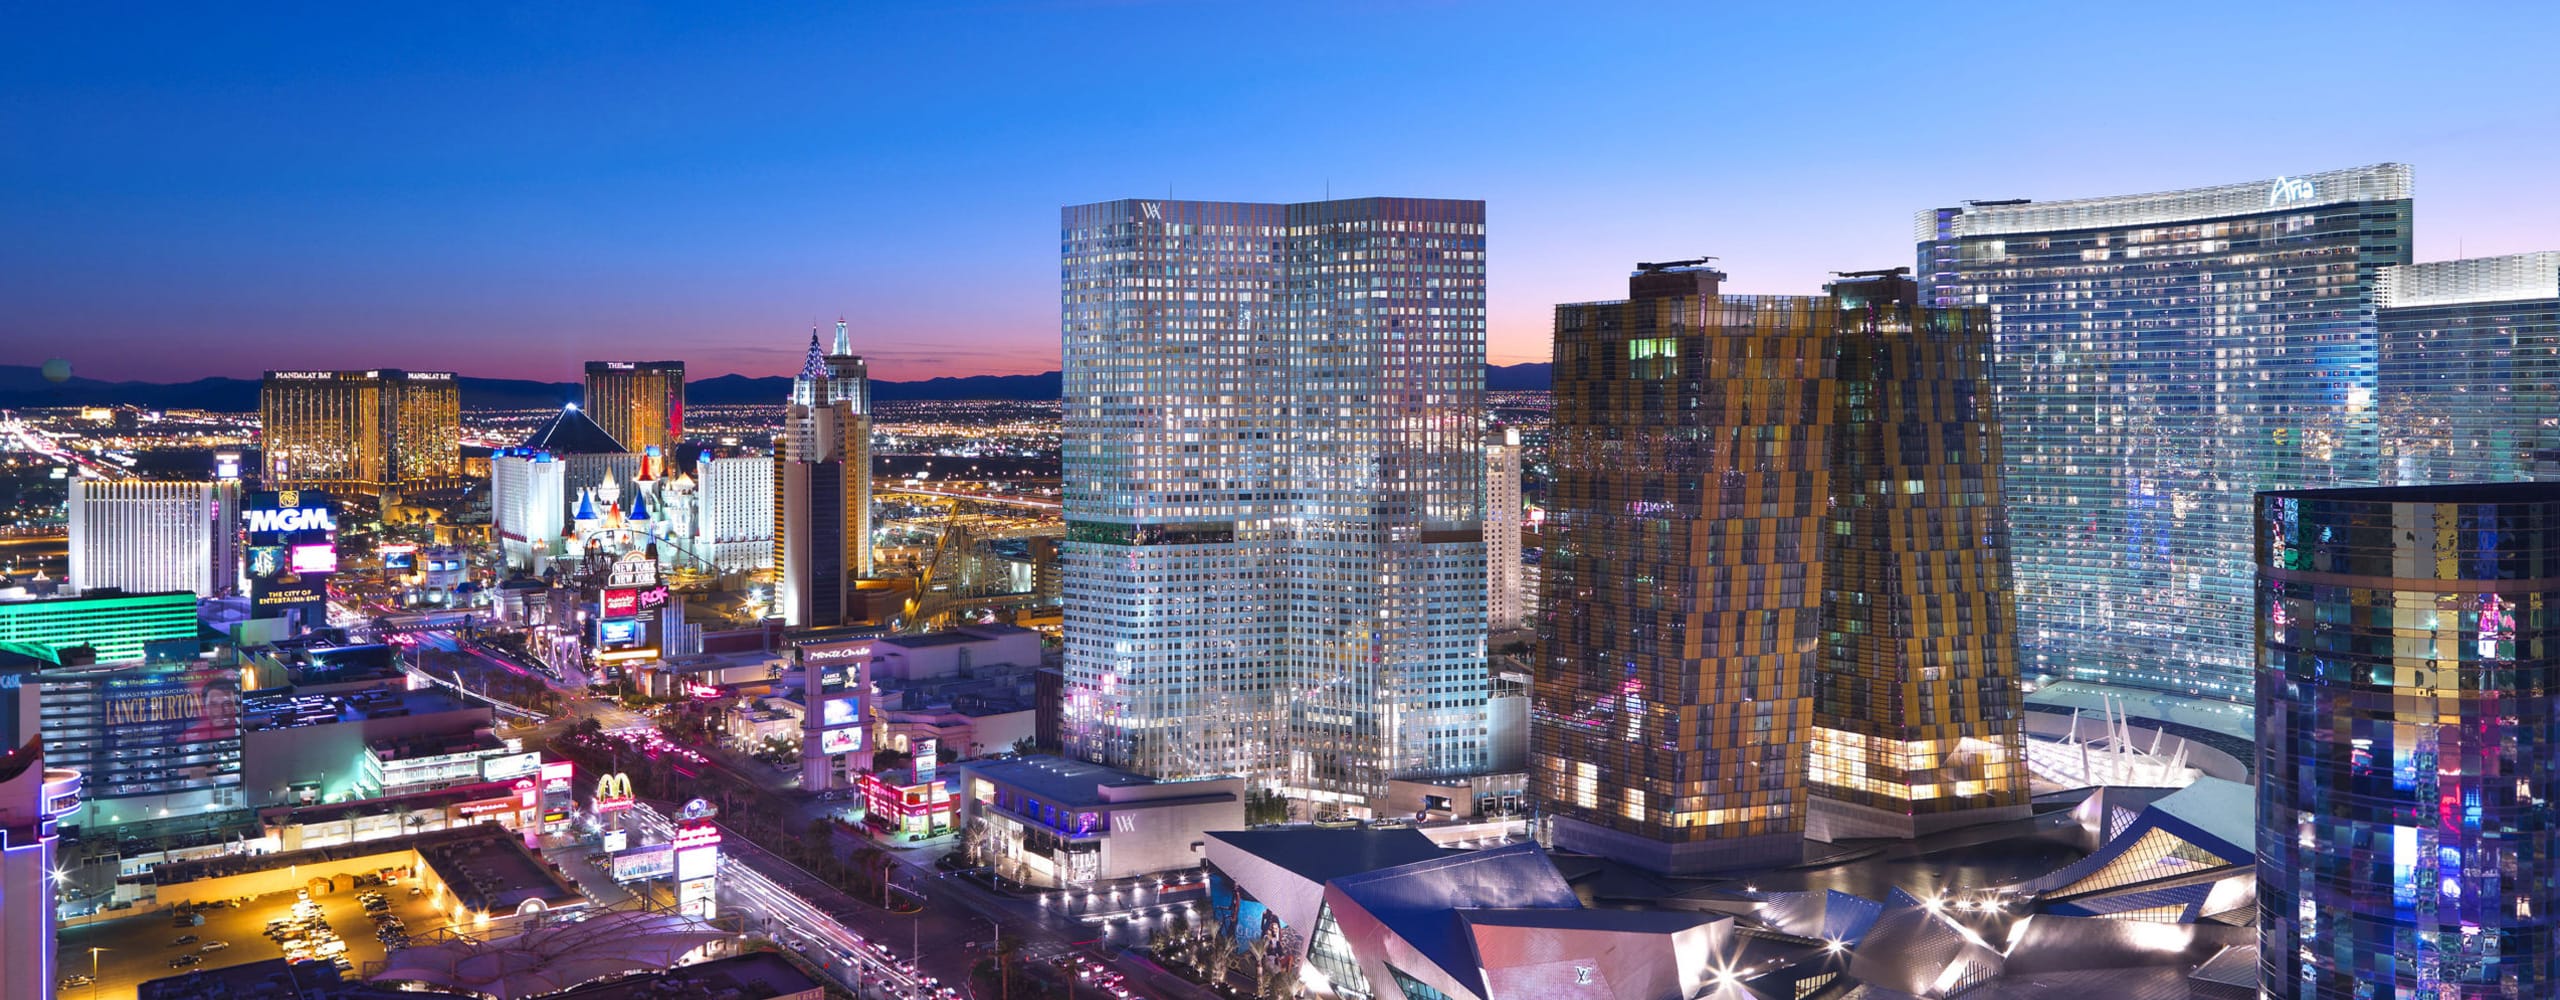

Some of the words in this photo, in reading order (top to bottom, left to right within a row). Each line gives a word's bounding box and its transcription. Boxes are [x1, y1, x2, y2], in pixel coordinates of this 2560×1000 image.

[2270, 176, 2314, 207] Aria
[250, 509, 327, 531] MGM
[615, 562, 633, 572] NEW
[634, 561, 656, 572] YORK
[615, 574, 633, 584] NEW
[634, 573, 656, 583] YORK
[810, 651, 841, 660] Monte
[841, 647, 871, 658] Carlo
[106, 698, 146, 725] LANCE
[151, 694, 202, 721] BURTON
[918, 743, 933, 751] CVS
[461, 802, 509, 814] Walgreens
[915, 808, 928, 816] CVS
